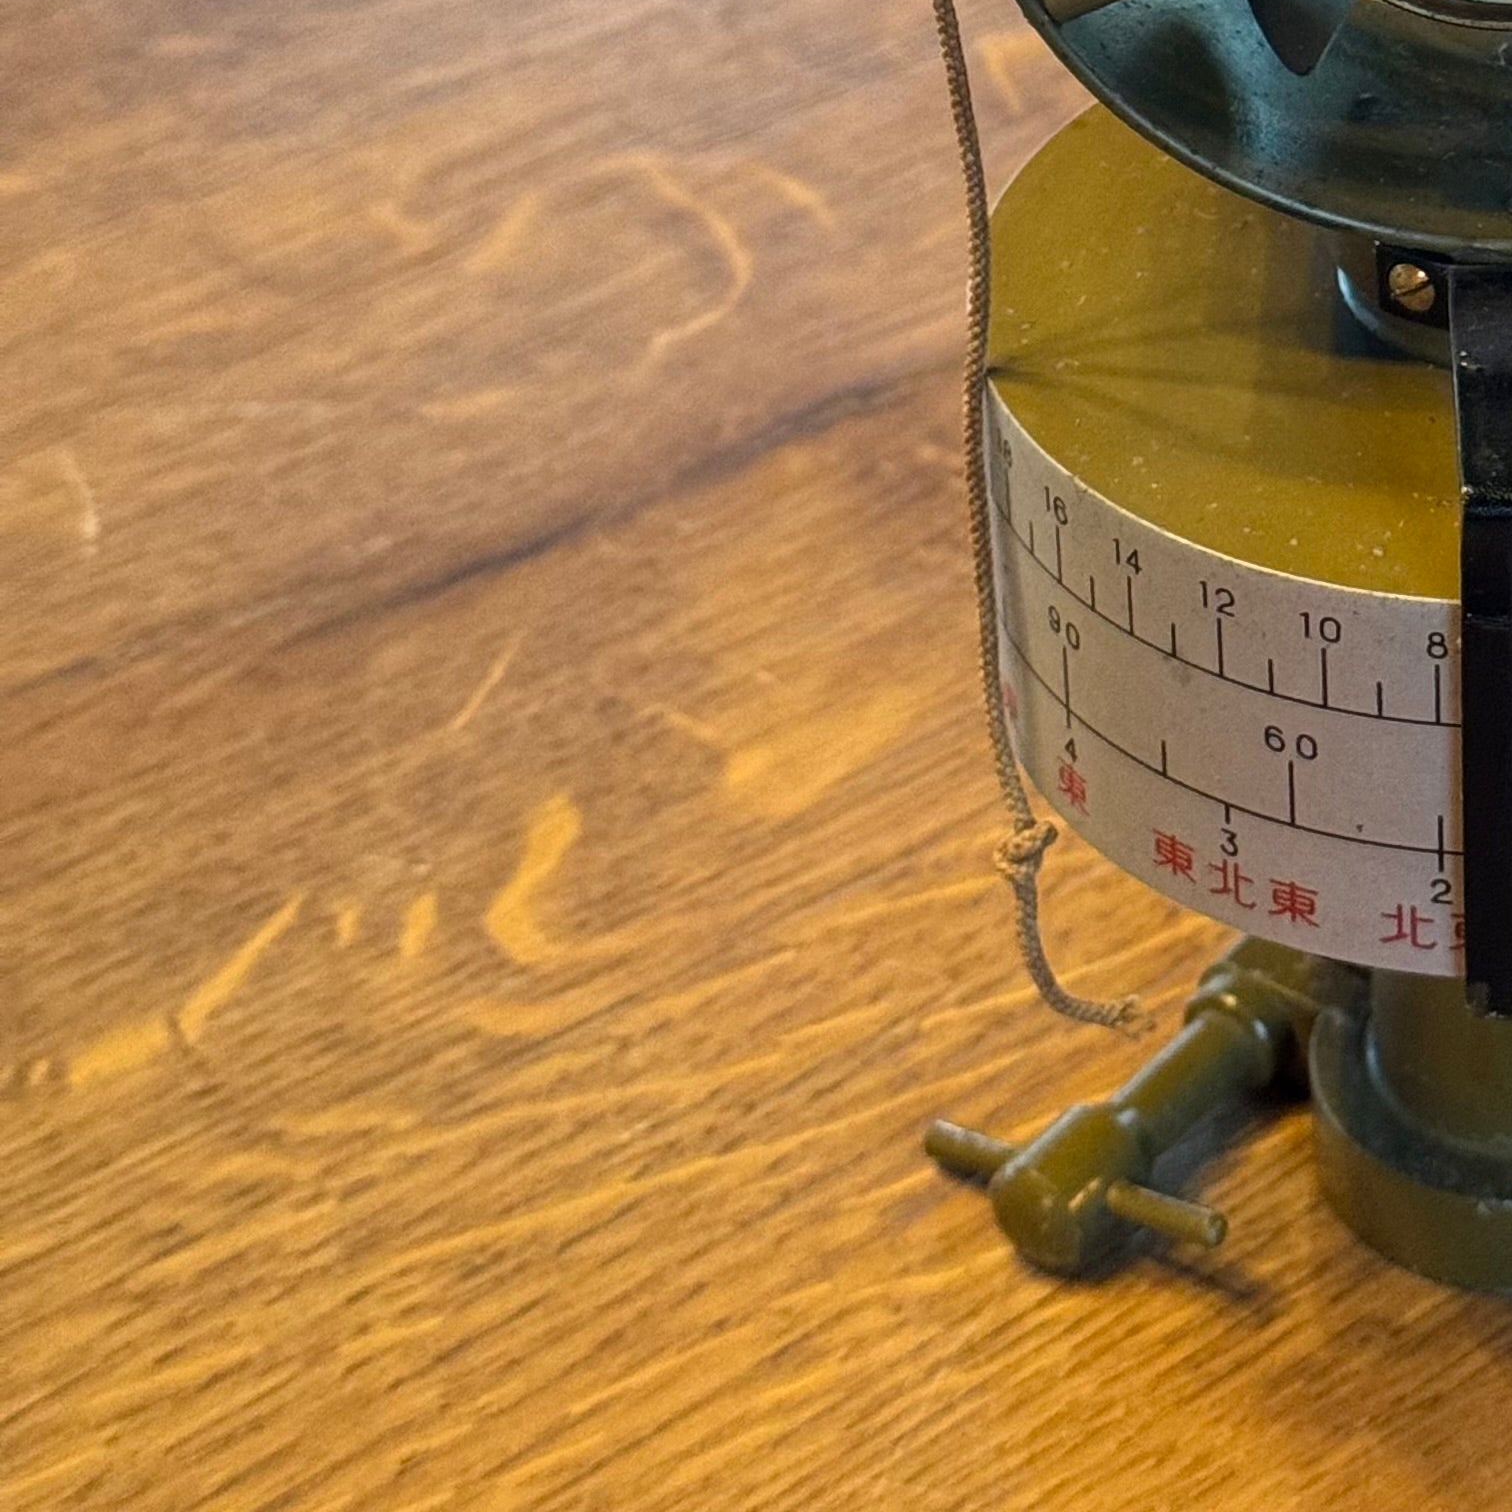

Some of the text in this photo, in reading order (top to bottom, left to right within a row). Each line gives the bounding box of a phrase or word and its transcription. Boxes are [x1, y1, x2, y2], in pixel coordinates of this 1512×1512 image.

[1043, 485, 1069, 526] 16
[1111, 538, 1143, 575] 14
[1200, 580, 1236, 618] 12
[1048, 604, 1080, 651] 90
[1300, 613, 1342, 644] 10
[1426, 633, 1448, 660] 8
[1065, 739, 1079, 763] 4
[1265, 725, 1319, 760] 60
[1220, 829, 1239, 857] 3
[1152, 829, 1320, 928] 東北東
[1431, 879, 1454, 905] 2
